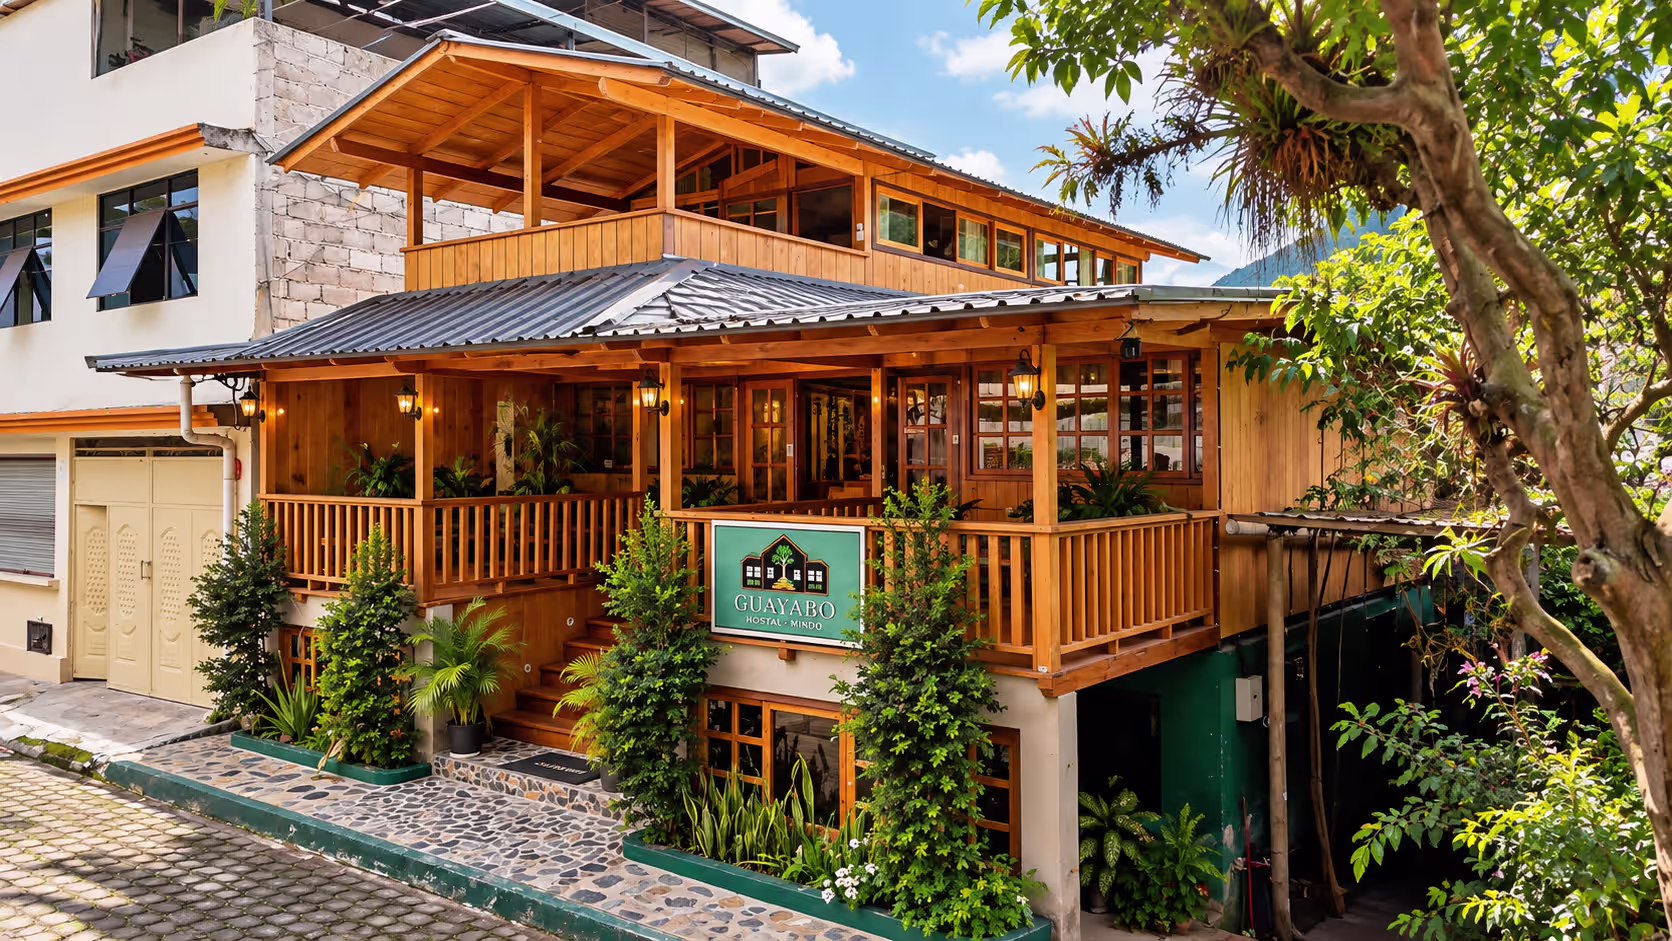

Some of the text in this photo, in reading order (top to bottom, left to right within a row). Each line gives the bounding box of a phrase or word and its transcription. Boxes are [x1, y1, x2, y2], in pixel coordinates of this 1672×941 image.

[735, 594, 836, 619] GUAYABO
[746, 616, 822, 631] HOSTAL MINDO
